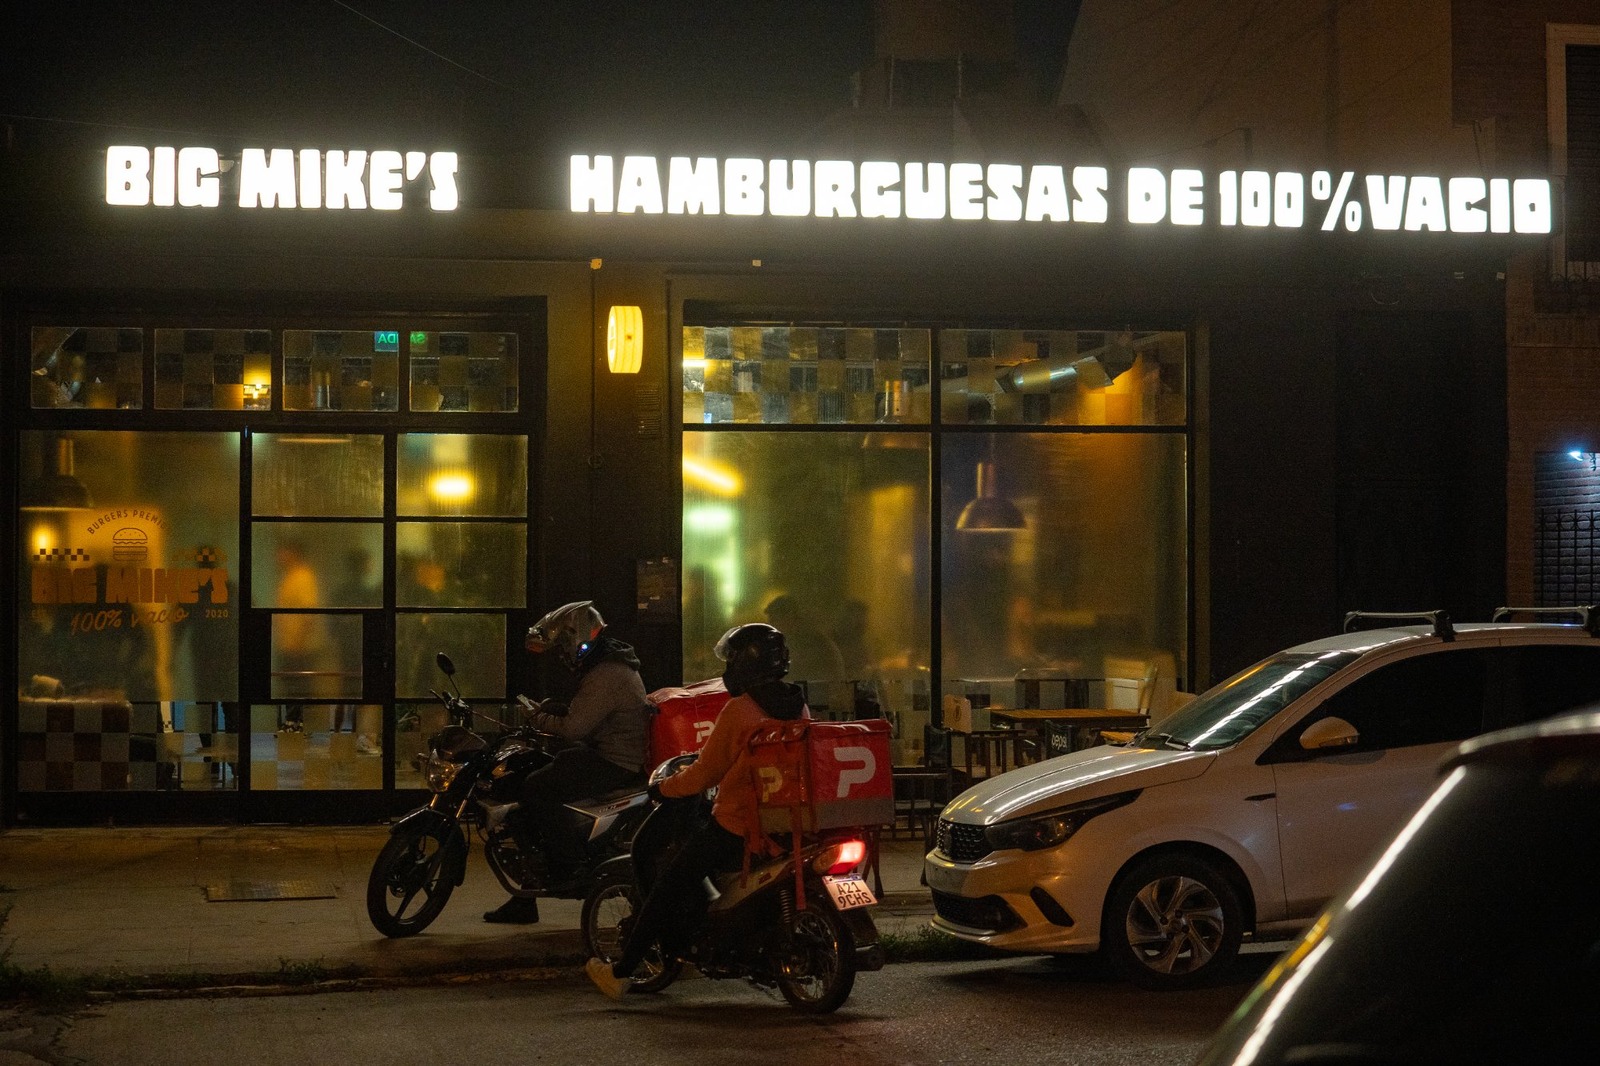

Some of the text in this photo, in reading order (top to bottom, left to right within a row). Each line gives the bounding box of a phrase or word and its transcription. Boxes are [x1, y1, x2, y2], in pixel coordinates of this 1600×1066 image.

[106, 145, 459, 212] BIG MIKE'S
[569, 153, 1109, 224] HAMBURGUESAS
[1127, 166, 1205, 226] DE
[87, 509, 128, 535] BURGERS
[31, 567, 229, 604] BIG MIKE'S
[70, 608, 125, 635] 100%
[205, 609, 229, 619] 2020
[836, 881, 862, 895] A21
[838, 892, 872, 908] 9CHS
